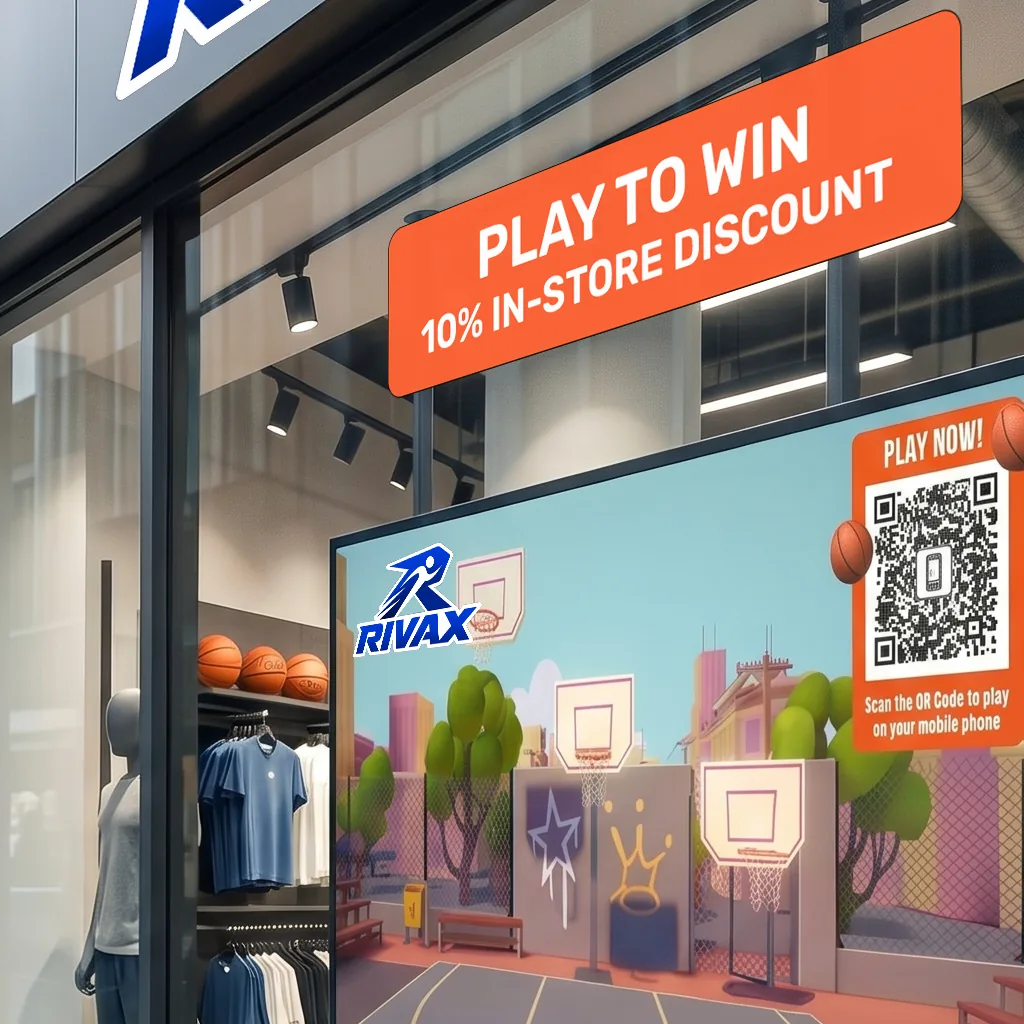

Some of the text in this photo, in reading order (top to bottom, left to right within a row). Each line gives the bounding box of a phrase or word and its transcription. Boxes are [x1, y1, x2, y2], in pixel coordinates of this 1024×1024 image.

[478, 105, 808, 279] PLAY TO WIN
[420, 157, 893, 354] 10% IN-STORE DISCOUNT
[884, 417, 984, 469] PLAY NOW!
[355, 606, 478, 655] RIVAX
[865, 696, 892, 714] Scan
[894, 693, 913, 712] the
[933, 689, 965, 709] Code
[967, 689, 980, 707] to
[983, 686, 1010, 710] play
[873, 713, 1001, 740] on your mobile phone
